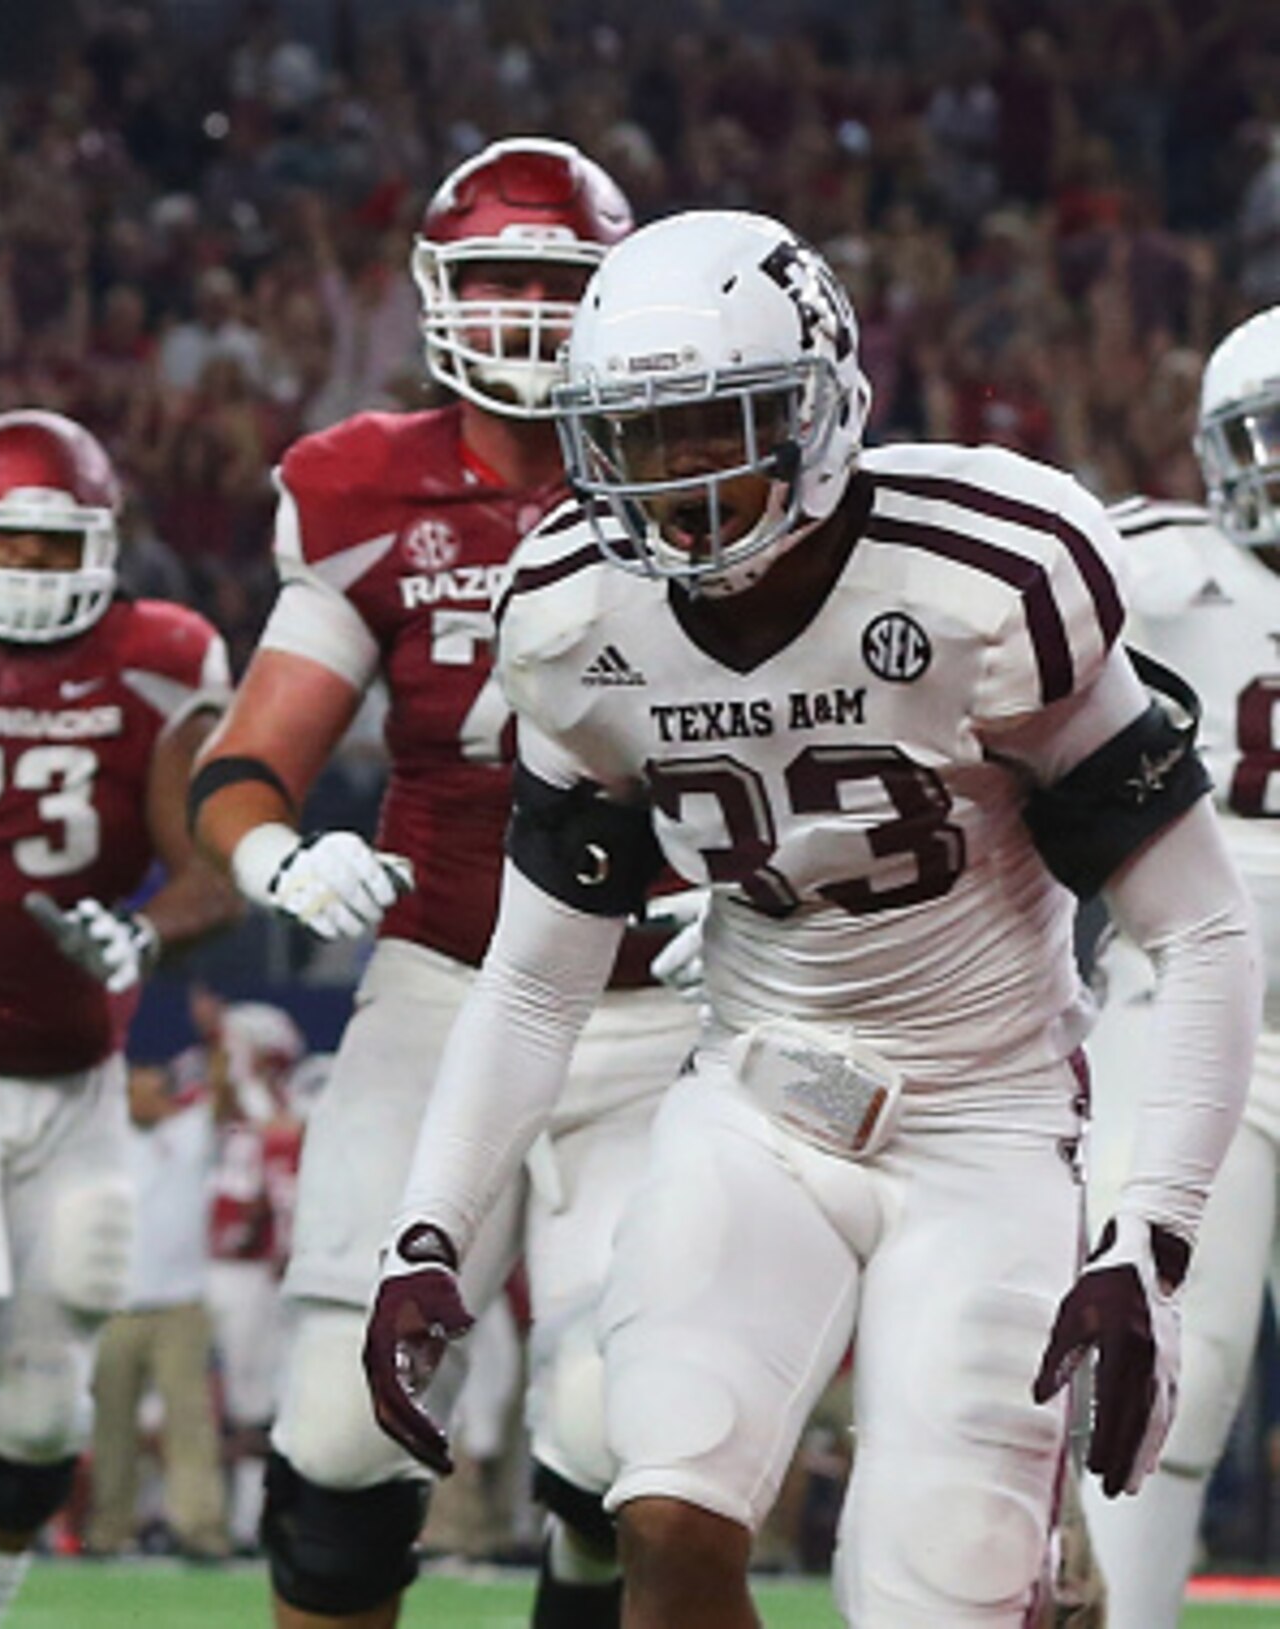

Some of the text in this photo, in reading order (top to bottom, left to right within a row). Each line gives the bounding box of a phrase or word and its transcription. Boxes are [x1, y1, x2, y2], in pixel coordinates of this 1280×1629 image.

[868, 618, 925, 678] SEC
[650, 687, 868, 742] TEXAS A&M
[643, 744, 967, 918] 33
